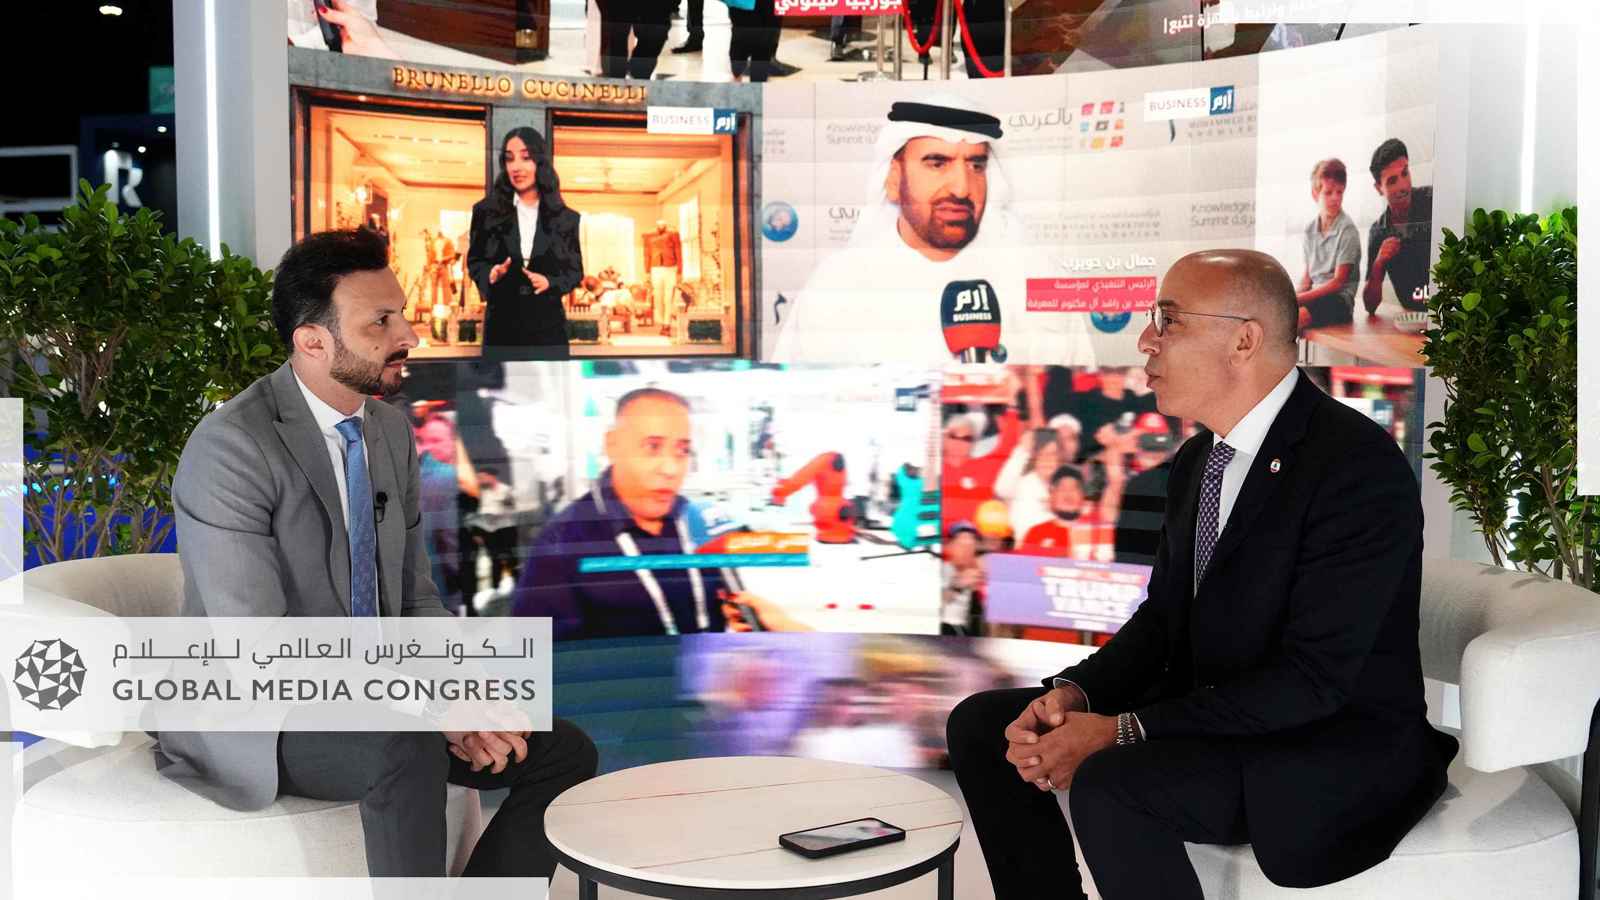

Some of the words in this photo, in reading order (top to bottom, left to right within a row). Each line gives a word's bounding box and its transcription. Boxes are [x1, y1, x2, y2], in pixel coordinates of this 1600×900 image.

[392, 66, 512, 92] BRUNELLO
[522, 78, 647, 102] CUCINELLI
[1149, 97, 1207, 112] BUSINESS
[1106, 256, 1121, 269] بن
[1125, 254, 1157, 269] جمال
